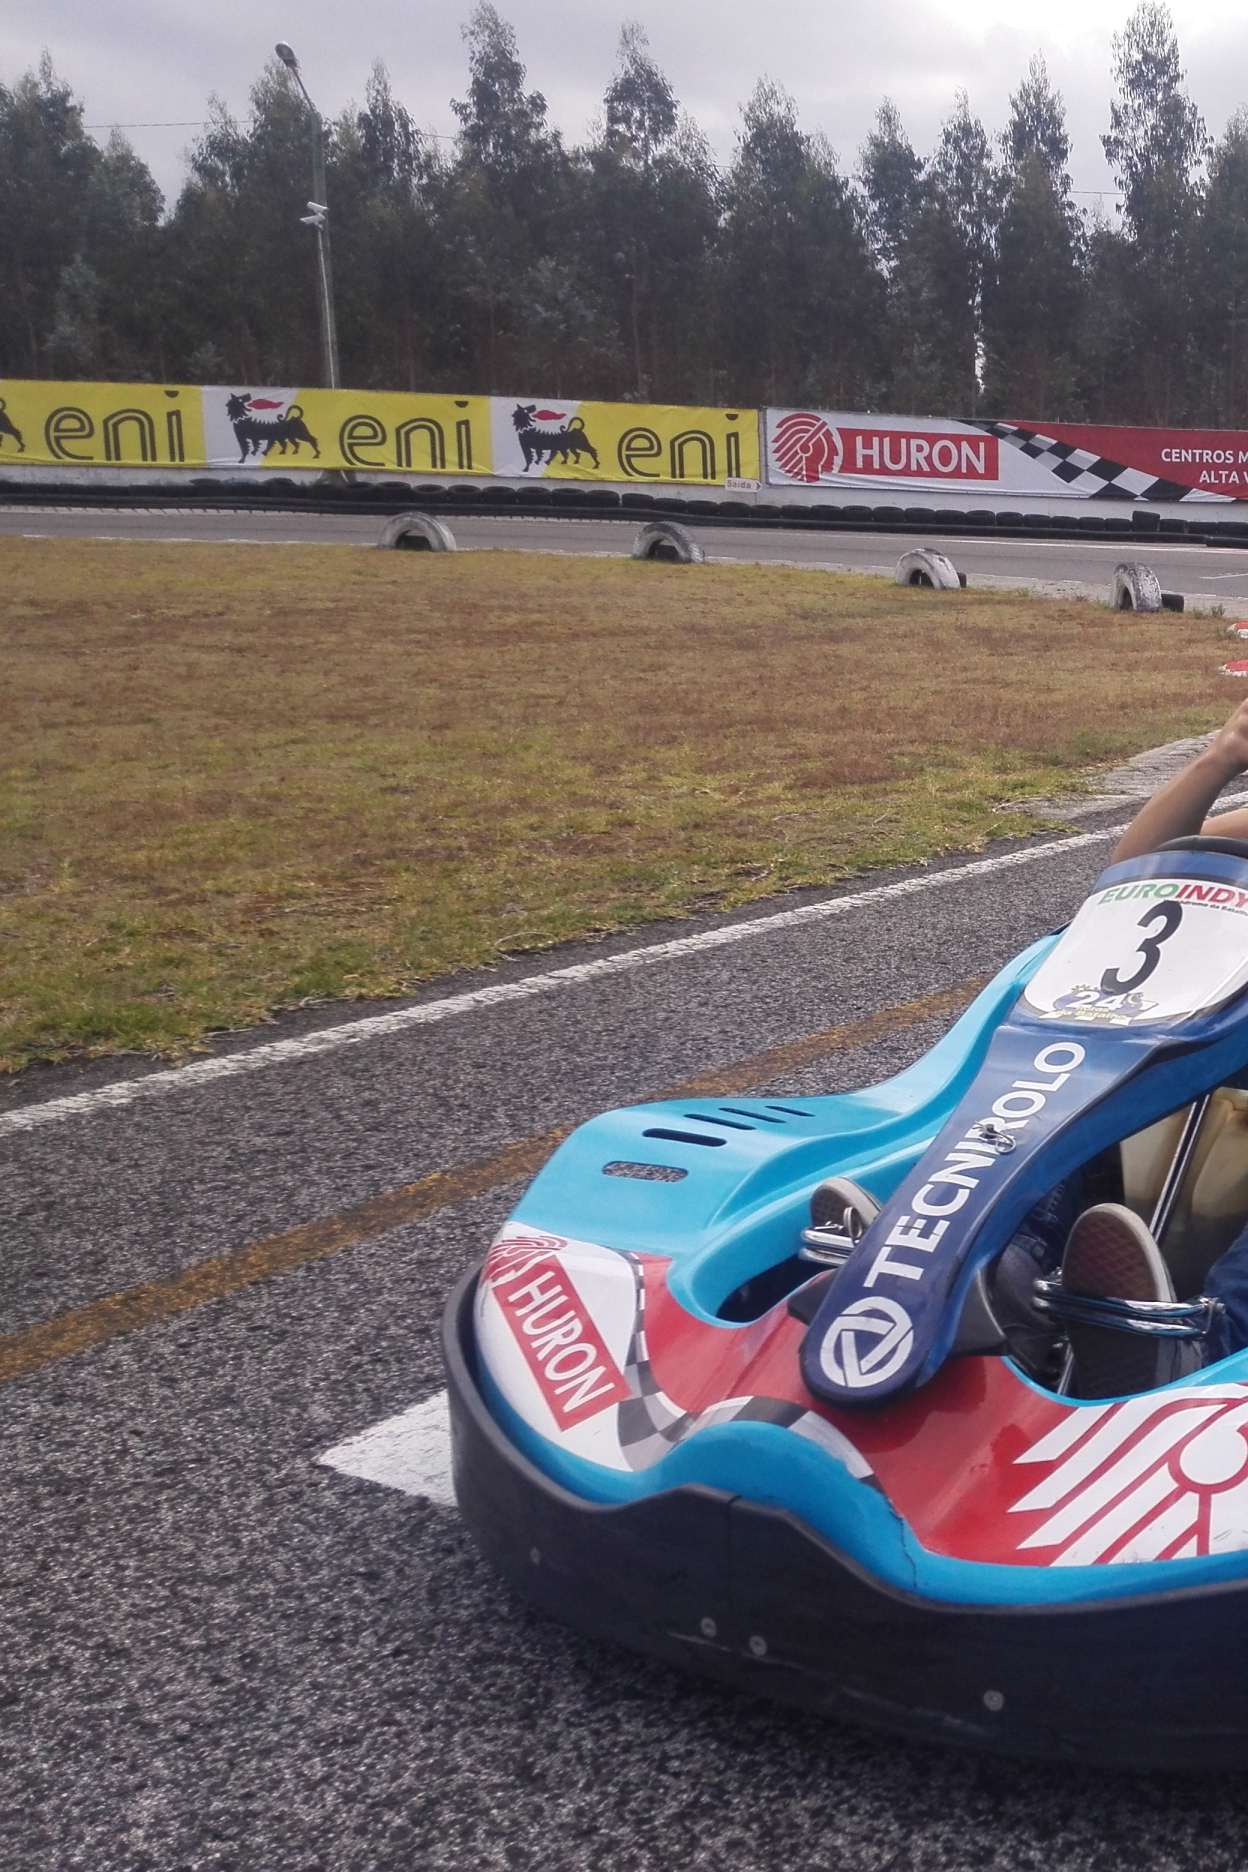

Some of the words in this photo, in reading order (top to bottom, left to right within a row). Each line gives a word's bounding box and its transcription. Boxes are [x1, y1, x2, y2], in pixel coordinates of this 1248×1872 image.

[45, 390, 184, 462] eni
[339, 400, 472, 470] eni
[617, 413, 741, 480] eni
[856, 435, 985, 474] HURON
[1161, 448, 1234, 464] CENTROS
[1199, 470, 1240, 484] ALTA
[1100, 899, 1184, 997] 3
[862, 1041, 1086, 1289] TECNIROLO
[507, 1271, 616, 1413] HURON
